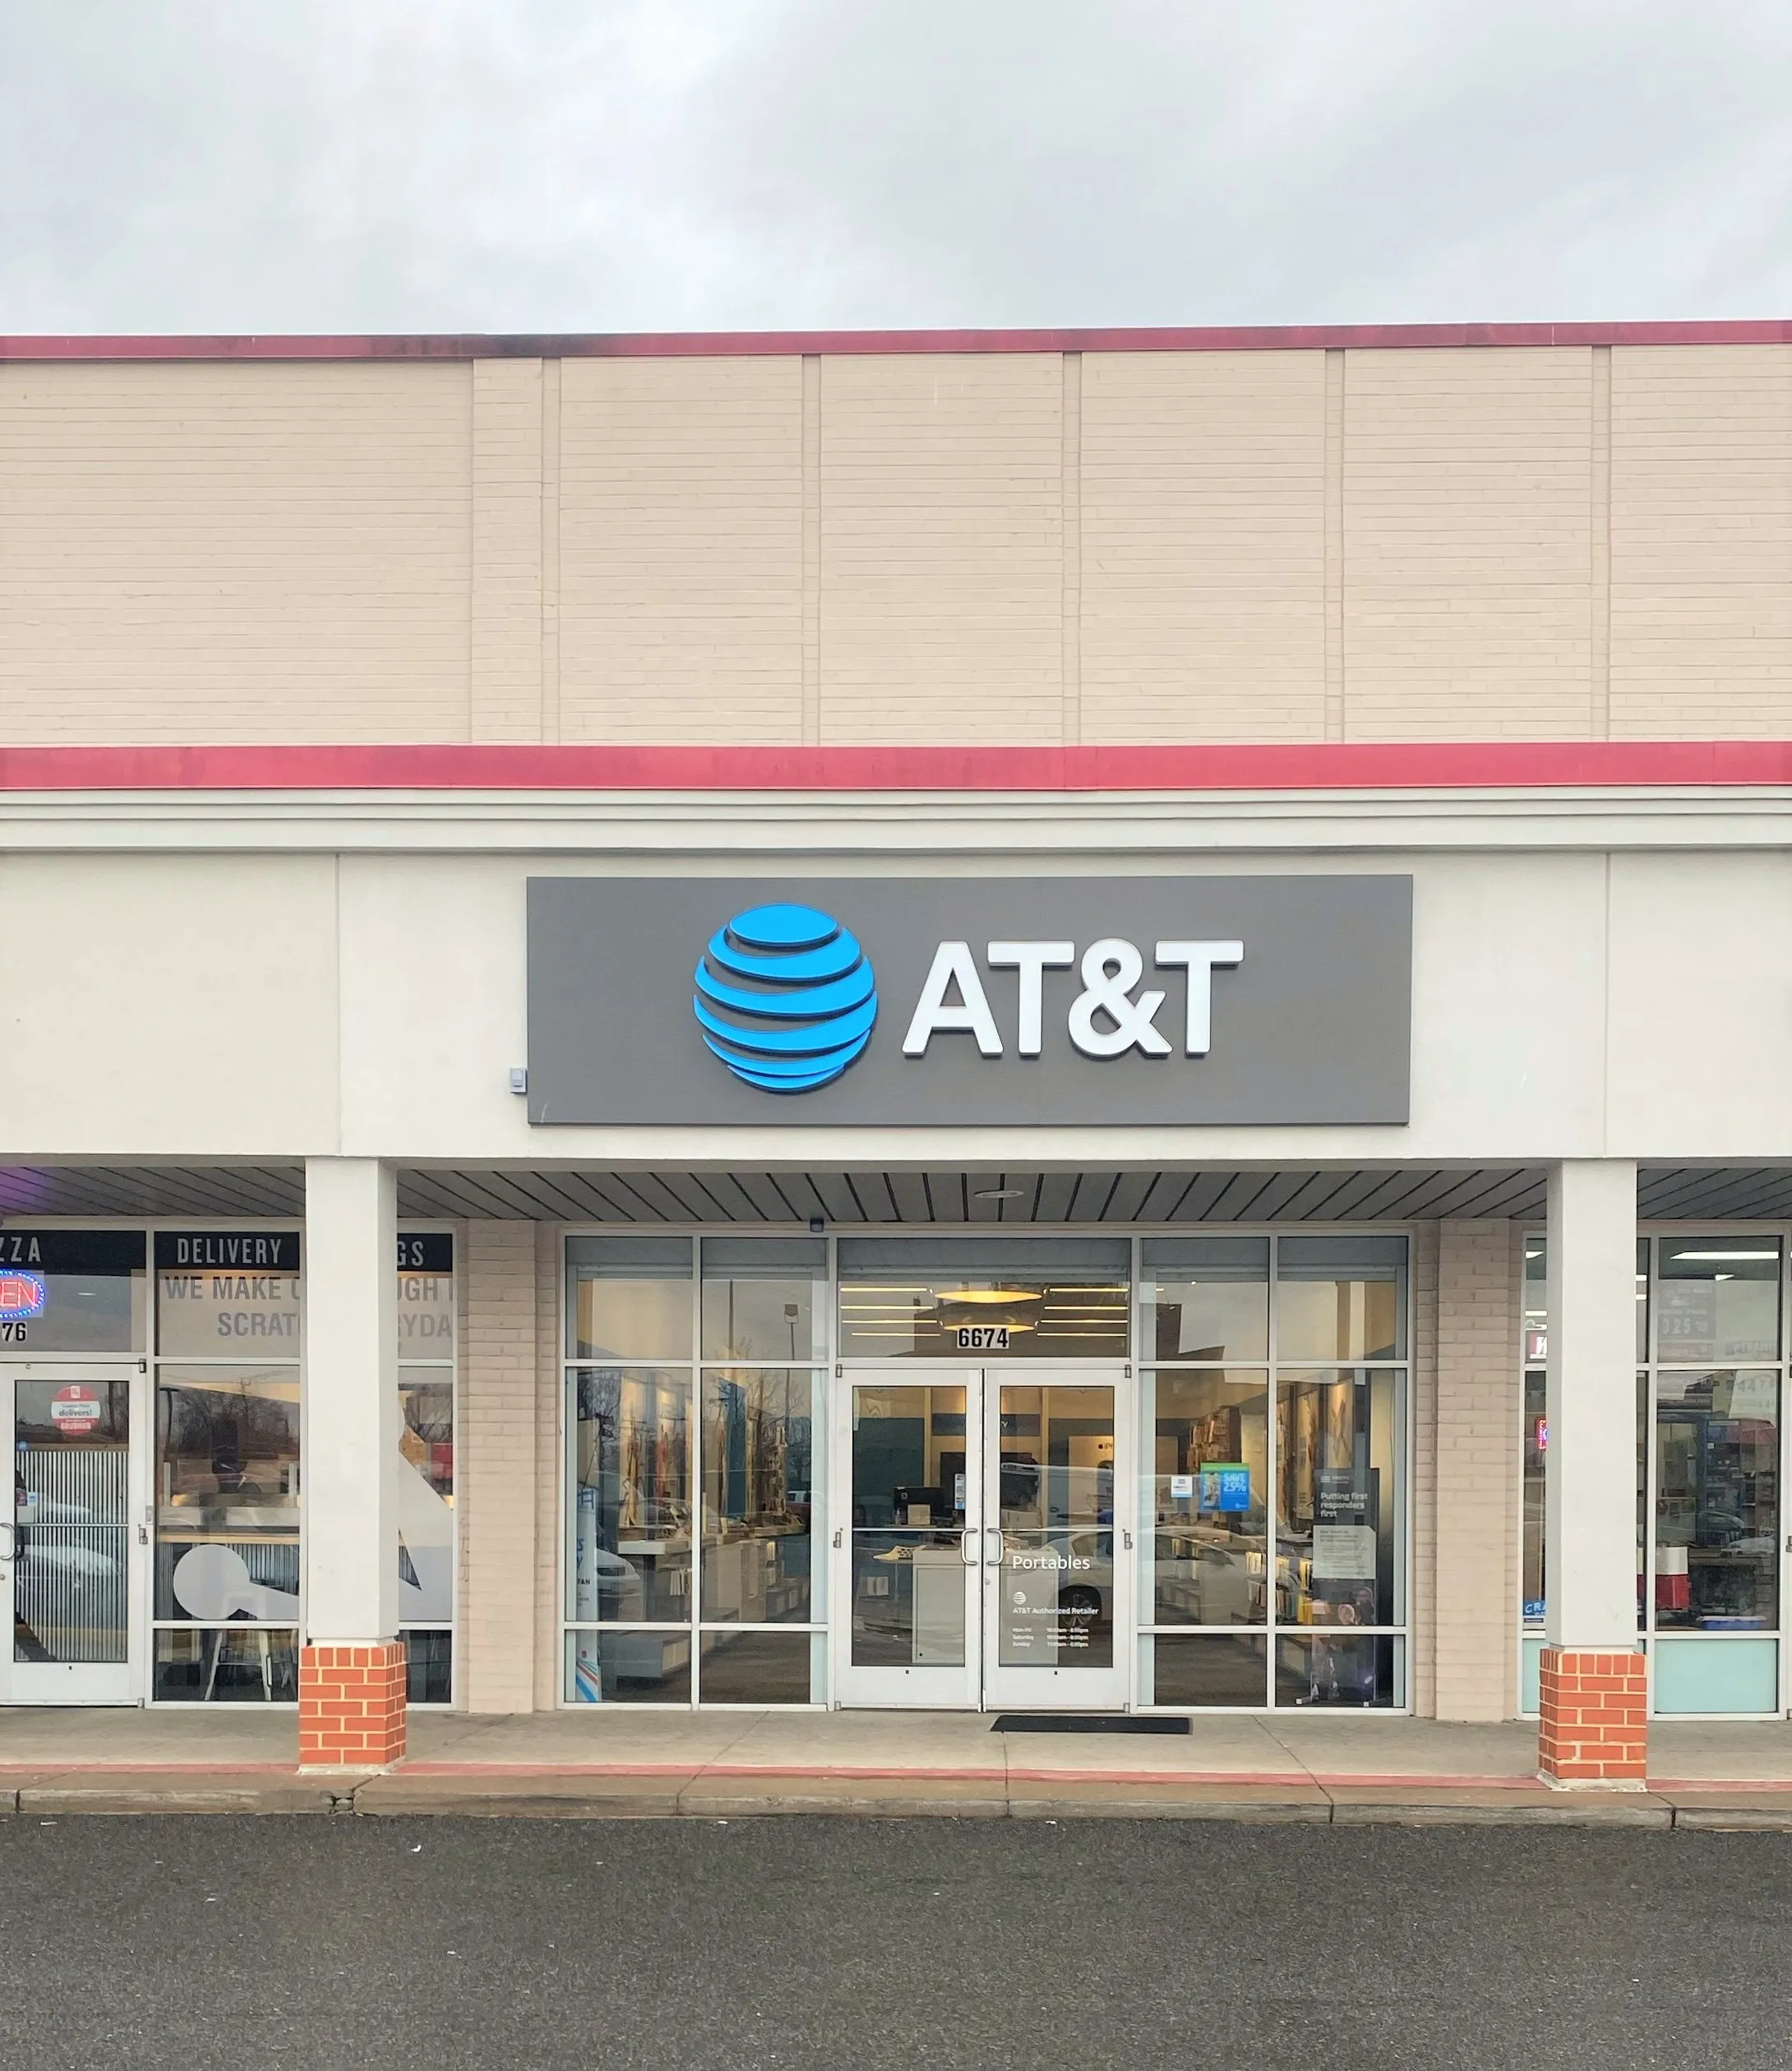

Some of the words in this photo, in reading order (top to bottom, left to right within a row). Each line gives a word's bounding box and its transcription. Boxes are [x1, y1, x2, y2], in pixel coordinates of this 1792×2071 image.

[902, 938, 1245, 1057] AT&T
[177, 1238, 282, 1264] DELIVERY
[164, 1276, 204, 1300] WE
[213, 1276, 282, 1300] MAKE
[217, 1311, 300, 1337] SCRAT
[958, 1328, 1008, 1348] 6674
[1223, 1472, 1245, 1482] SAVE
[1320, 1492, 1350, 1502] Putting
[1351, 1491, 1369, 1500] first
[1320, 1500, 1365, 1510] responders
[1320, 1509, 1337, 1518] first
[1012, 1555, 1091, 1570] Portables
